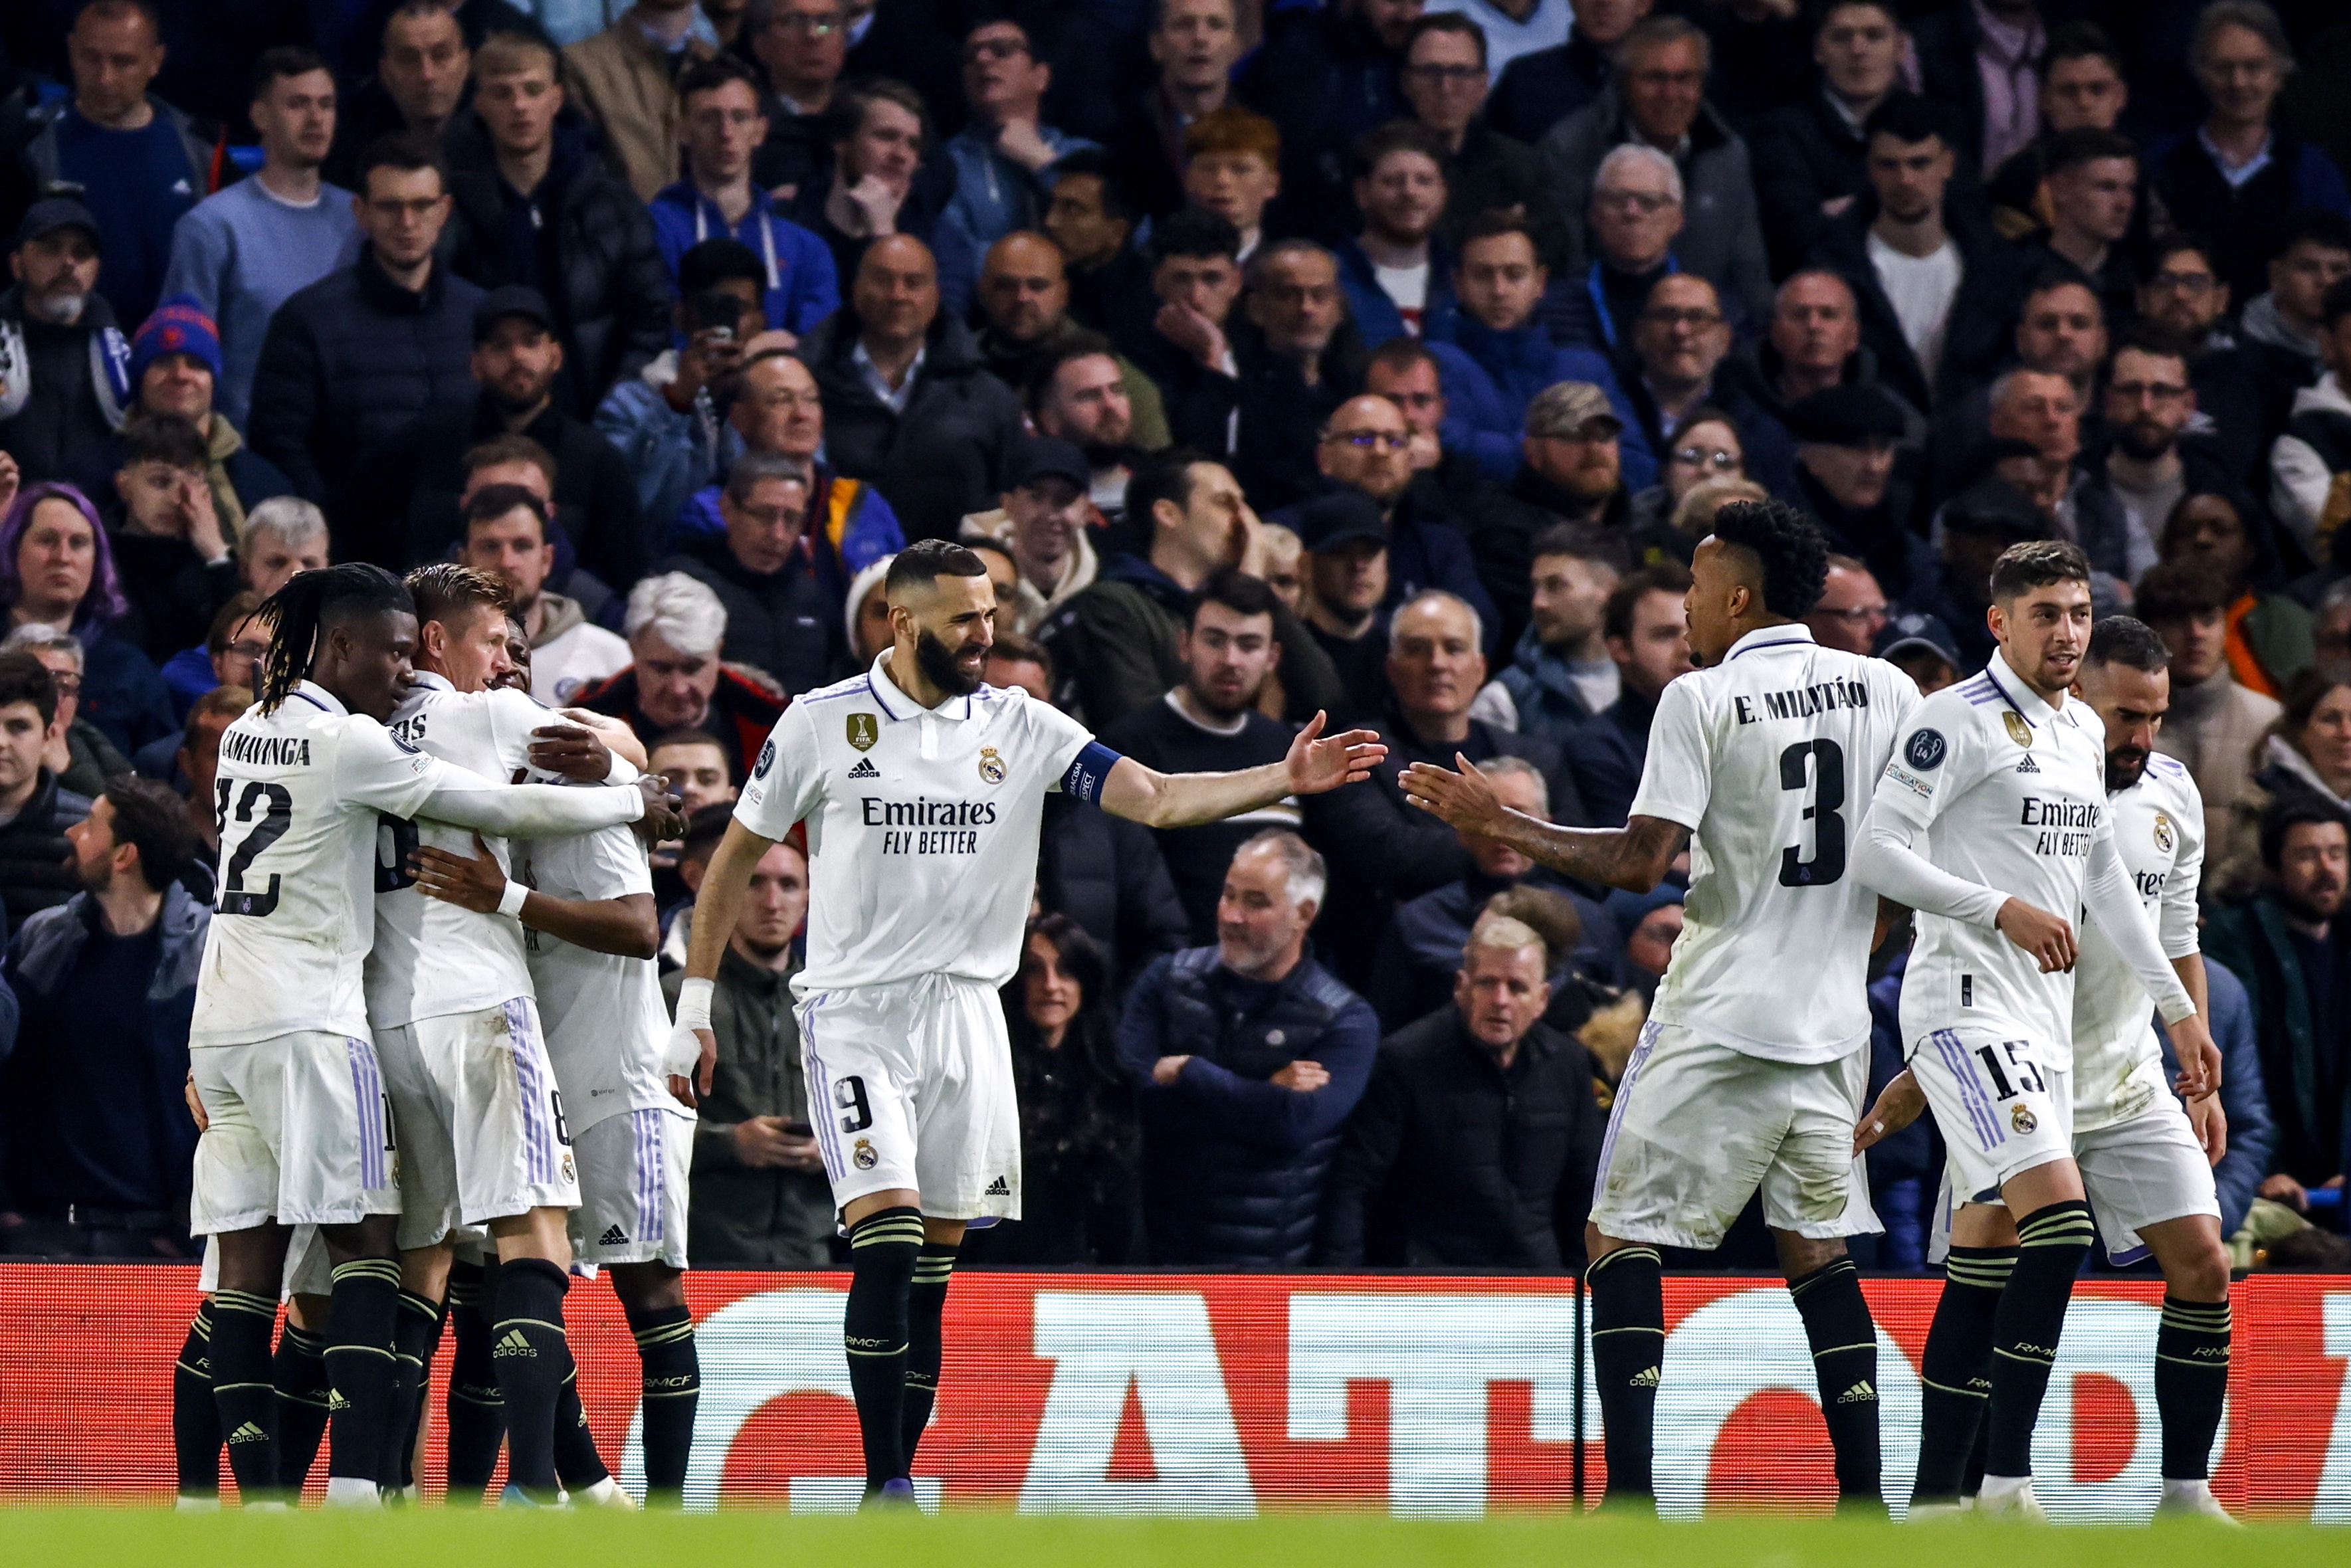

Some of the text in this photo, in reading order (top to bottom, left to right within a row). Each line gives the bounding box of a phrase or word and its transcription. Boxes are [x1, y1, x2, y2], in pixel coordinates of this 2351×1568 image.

[1734, 695, 1762, 725] E.
[393, 714, 427, 741] OS
[848, 769, 880, 779] adidas
[1081, 772, 1093, 801] ESPECT
[1886, 767, 1933, 795] FOUNDATION
[861, 795, 996, 826] Emirates
[1779, 738, 1845, 887] 3
[2021, 797, 2100, 828] Emirate
[883, 831, 977, 854] FLY BETTER
[2036, 831, 2091, 856] FLY BETTE
[1975, 1040, 2045, 1102] 15
[833, 1075, 872, 1133] 9
[599, 1236, 629, 1246] adidas
[493, 1344, 537, 1358] adidas
[1837, 1392, 1878, 1403] adidas
[229, 1432, 269, 1444] adidas
